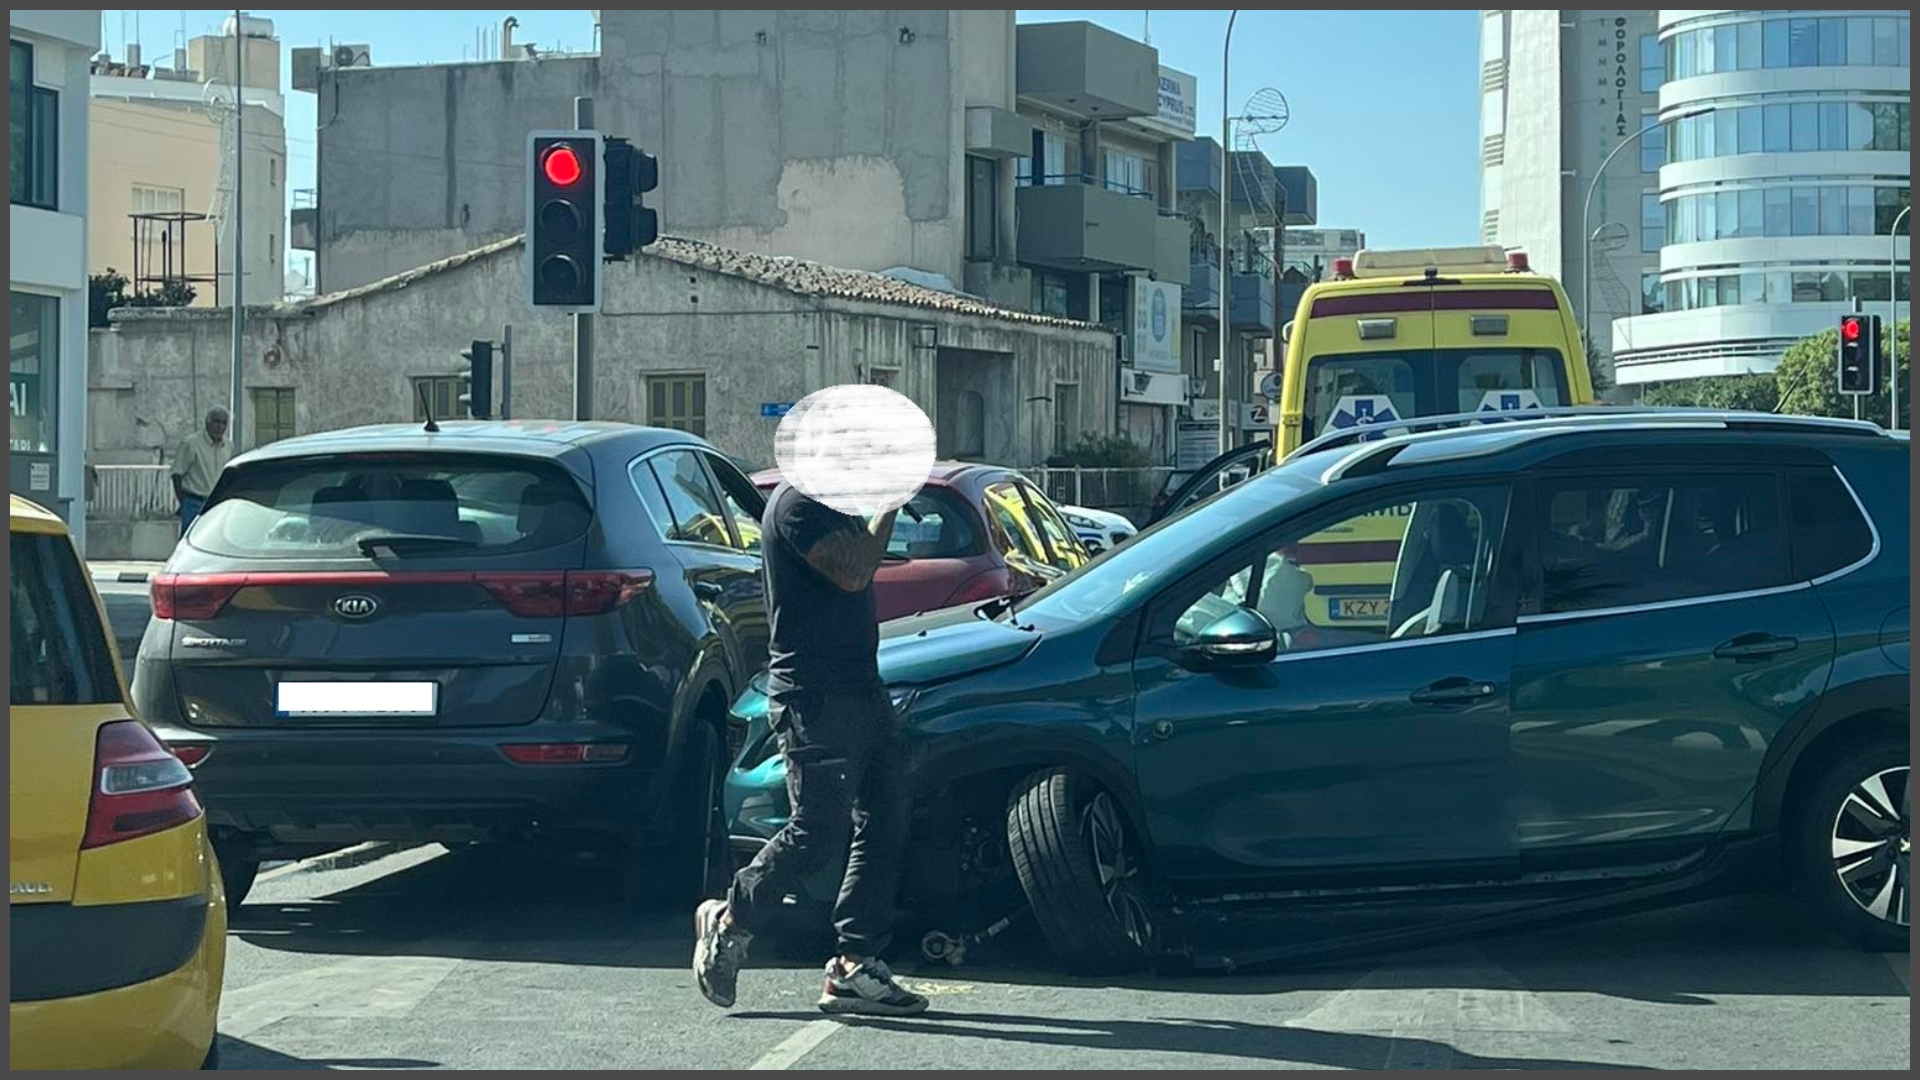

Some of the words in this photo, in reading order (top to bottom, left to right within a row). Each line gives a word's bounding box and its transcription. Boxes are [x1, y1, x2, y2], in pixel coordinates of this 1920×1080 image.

[1615, 17, 1626, 136] ΦΟΡΟΛΟΓΙΑΣ
[342, 600, 369, 612] KIA
[1344, 601, 1379, 615] KZY
